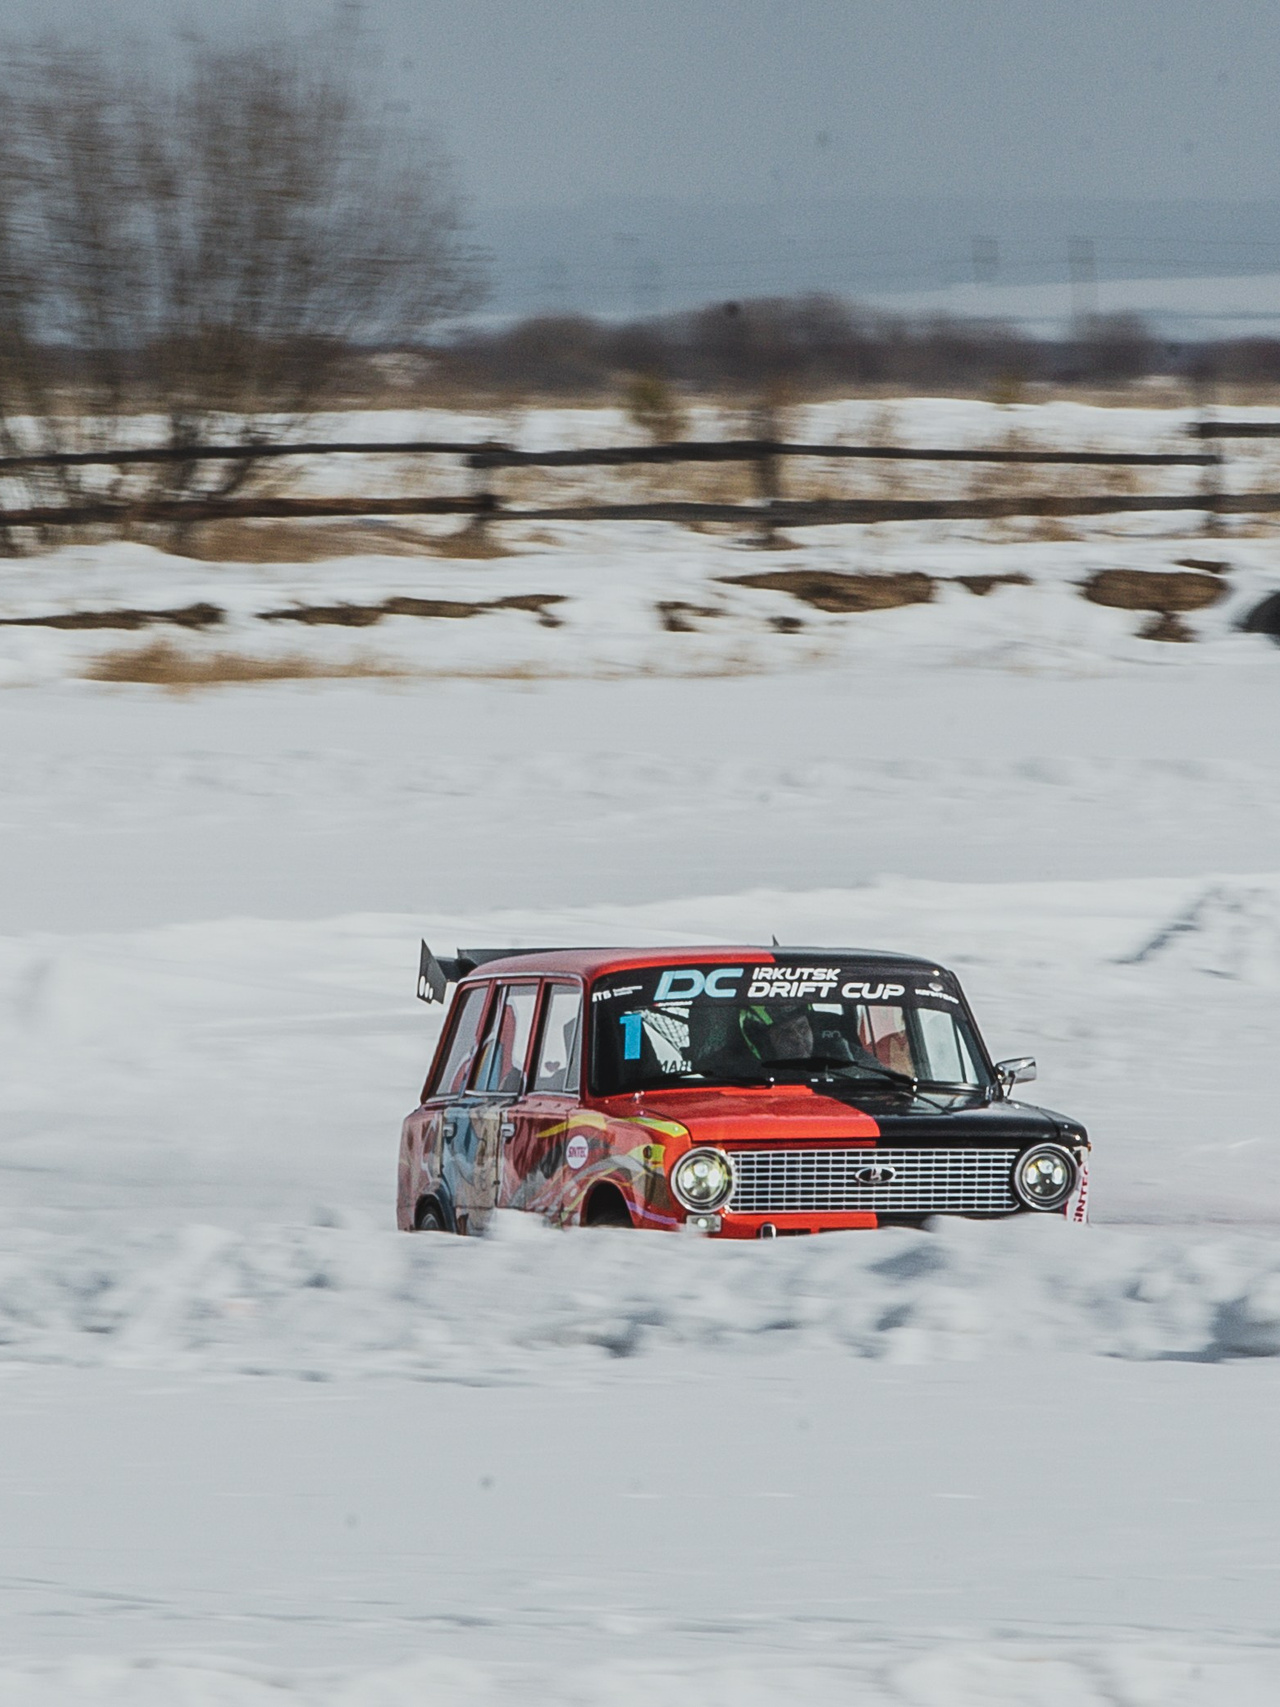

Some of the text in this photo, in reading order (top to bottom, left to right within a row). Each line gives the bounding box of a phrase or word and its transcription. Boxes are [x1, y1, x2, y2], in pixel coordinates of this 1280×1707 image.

[752, 967, 841, 981] IRKUTSK
[747, 981, 838, 998] DRIFT
[841, 982, 906, 1000] CUP
[619, 1013, 642, 1060] 1
